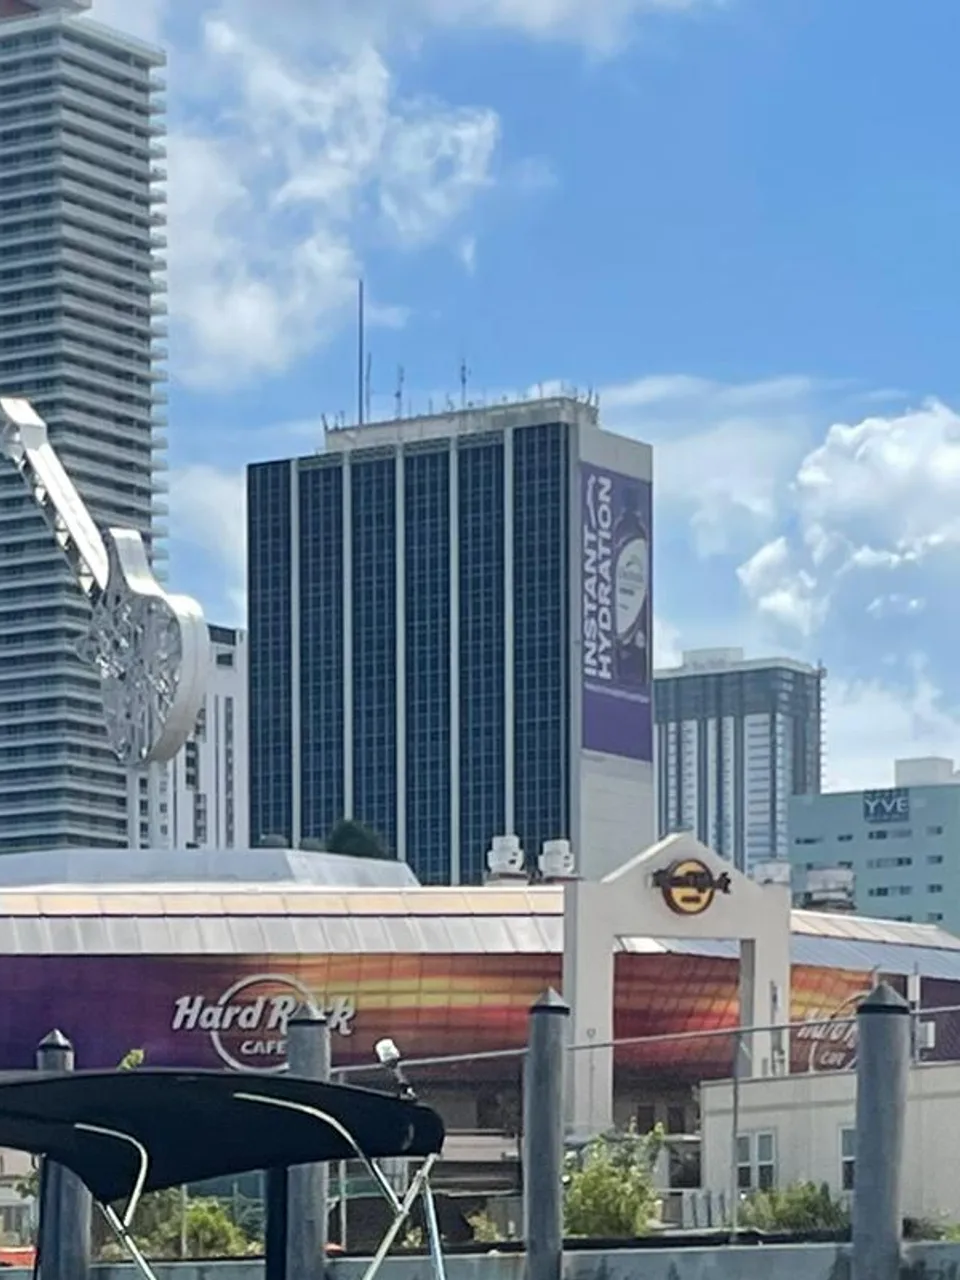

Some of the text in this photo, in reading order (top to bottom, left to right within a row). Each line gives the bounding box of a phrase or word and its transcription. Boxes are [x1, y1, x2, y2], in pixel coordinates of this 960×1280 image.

[583, 524, 597, 677] INSTANT
[597, 475, 613, 681] HYDRATION
[865, 797, 909, 814] YVE
[172, 995, 265, 1031] Hard
